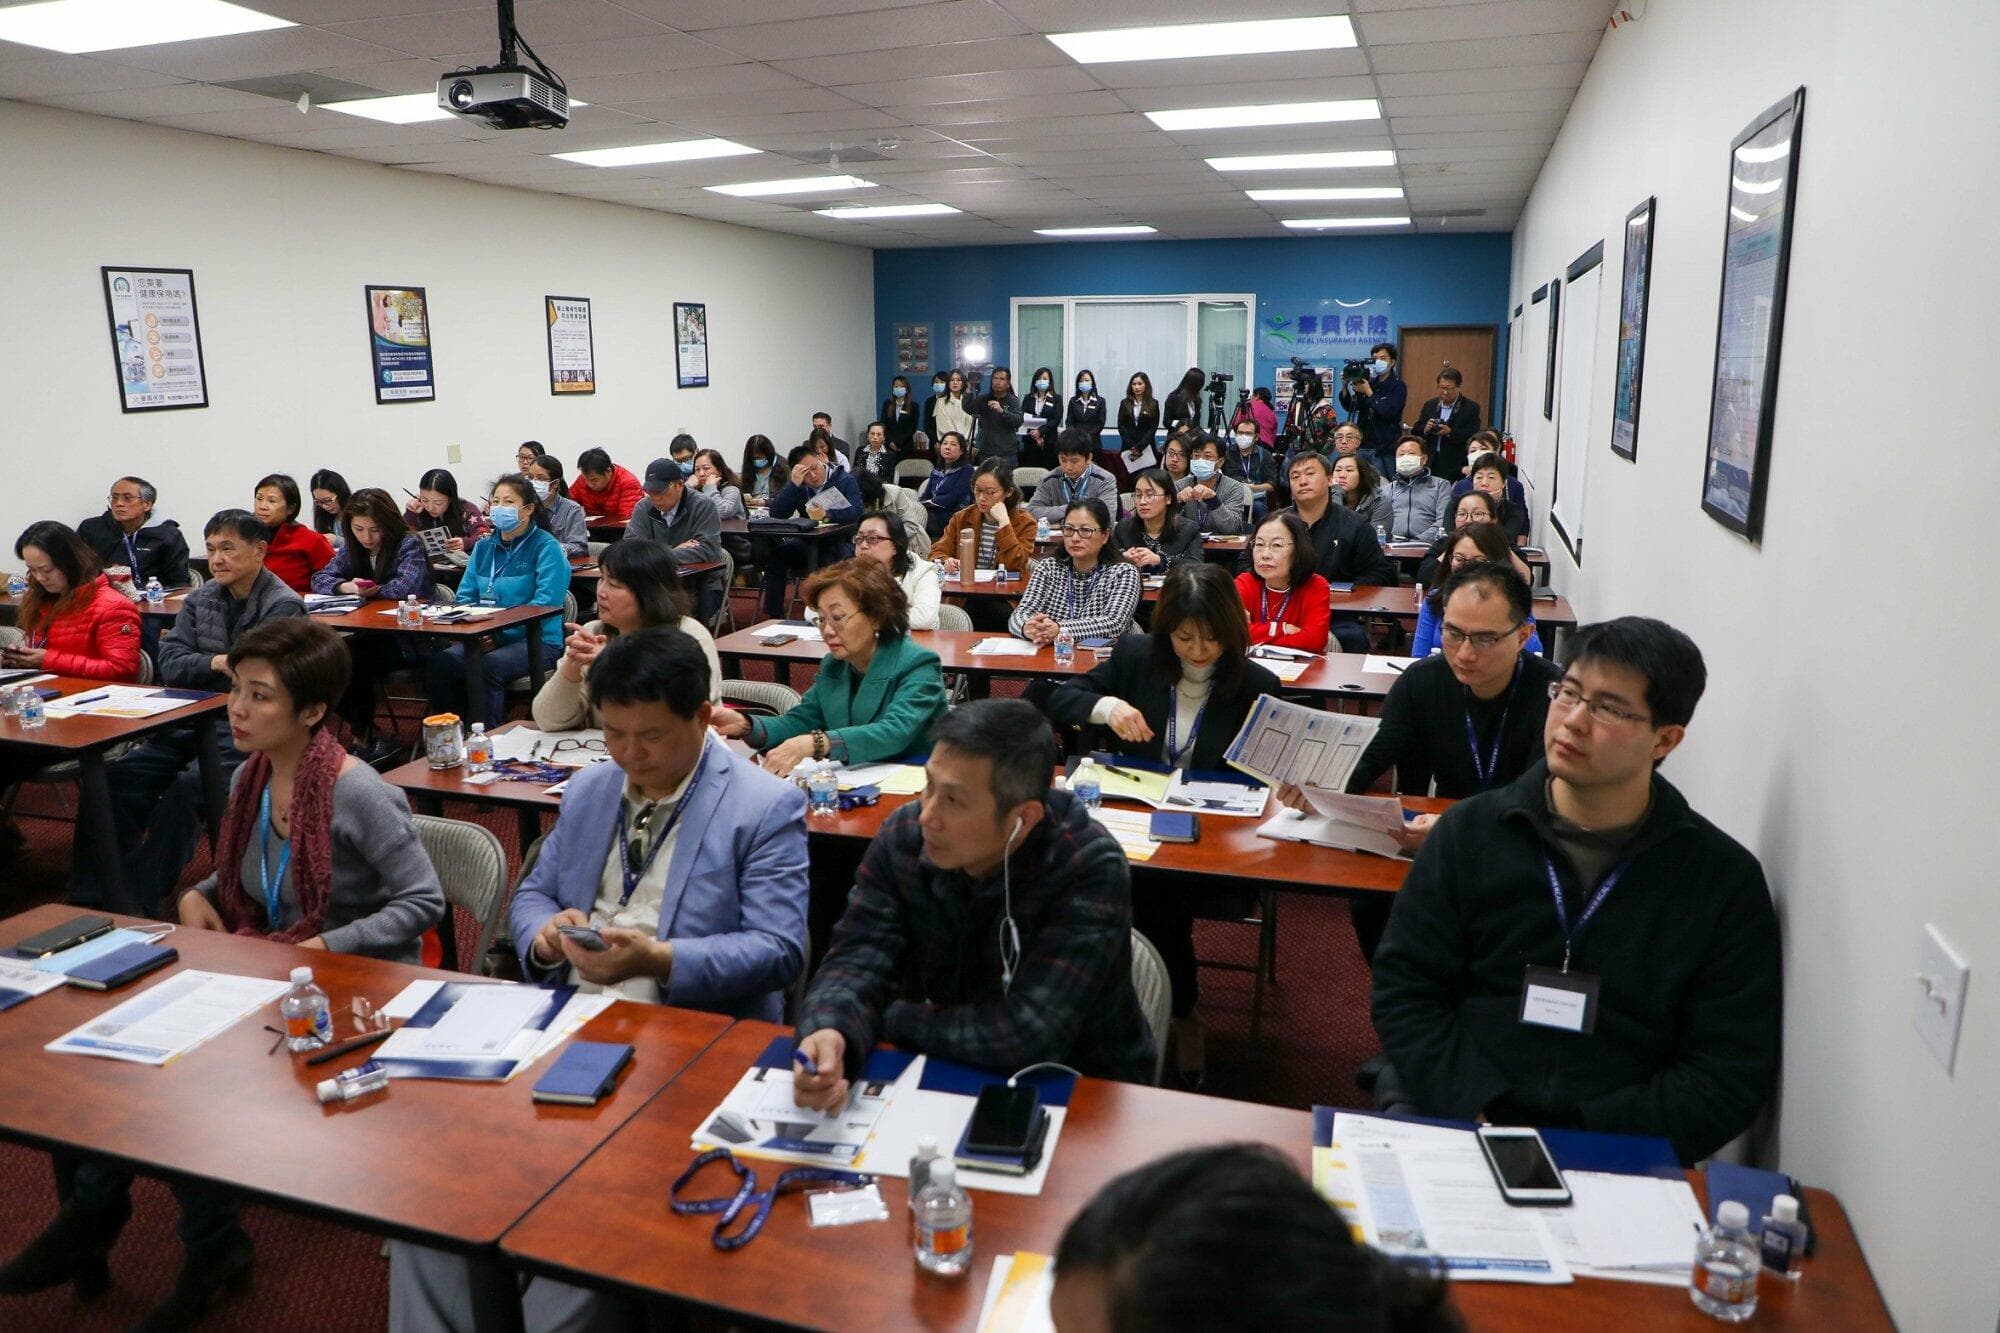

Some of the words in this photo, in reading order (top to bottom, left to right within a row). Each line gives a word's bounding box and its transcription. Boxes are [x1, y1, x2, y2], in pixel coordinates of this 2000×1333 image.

[1298, 315, 1388, 335] 華興保險
[1316, 336, 1357, 345] INSURANCE
[1358, 336, 1387, 345] AGENCY
